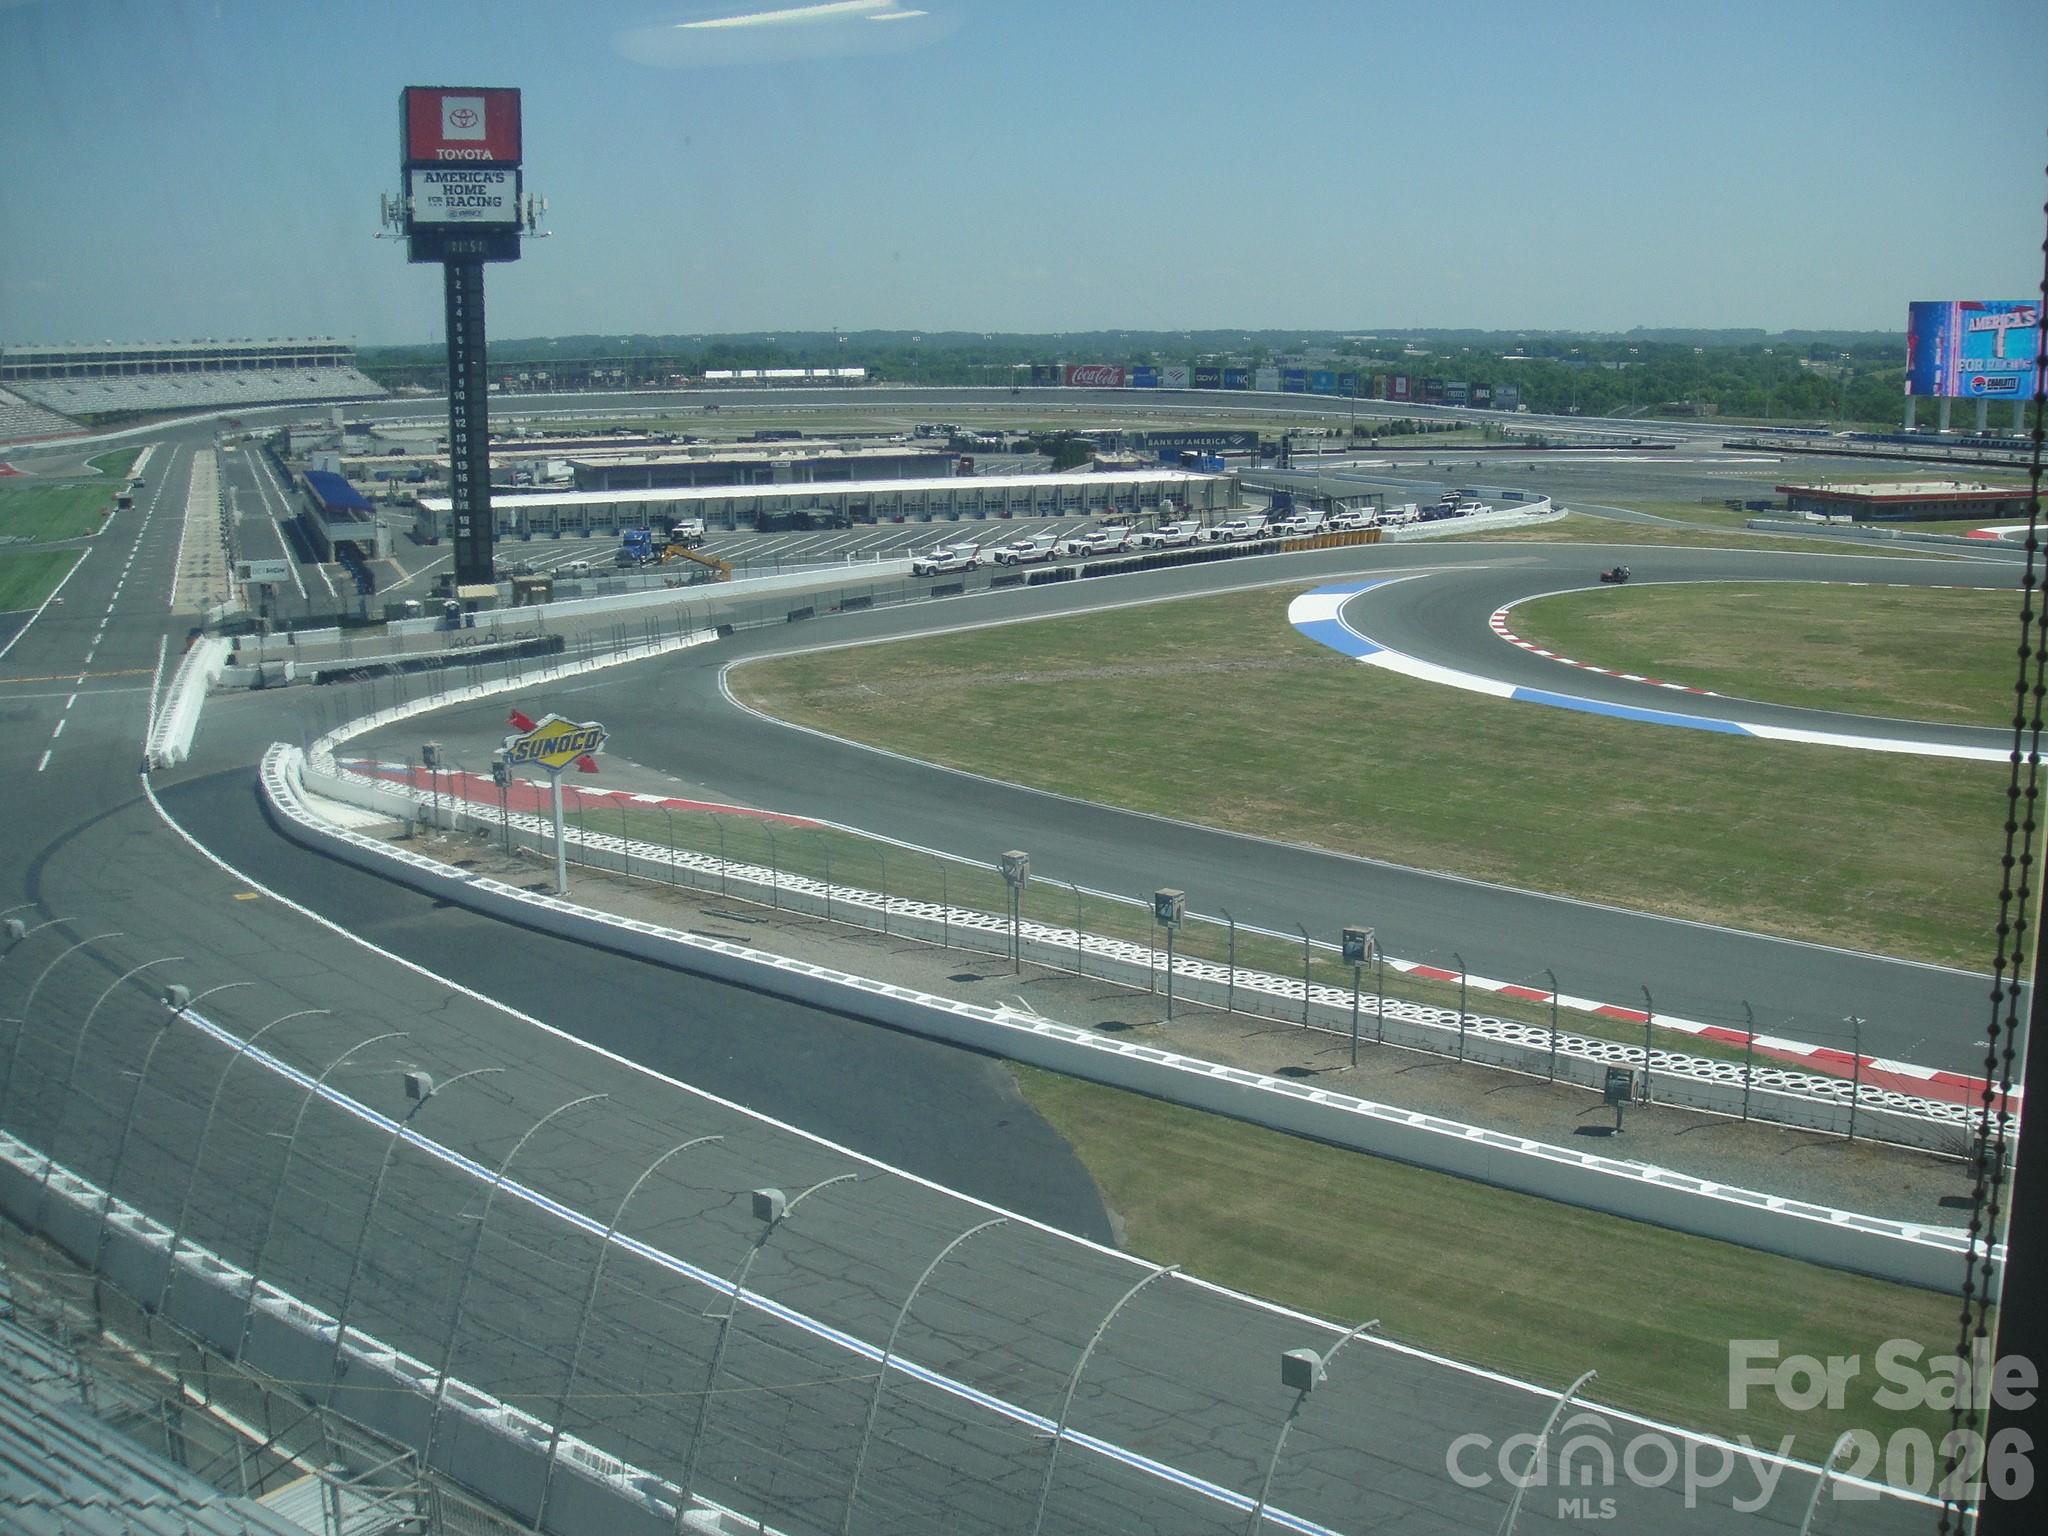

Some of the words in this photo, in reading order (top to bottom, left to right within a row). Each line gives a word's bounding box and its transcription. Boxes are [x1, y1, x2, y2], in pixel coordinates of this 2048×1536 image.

[436, 149, 493, 161] TOYOTA
[424, 172, 505, 184] AMERICA'S
[443, 184, 487, 195] HOME
[445, 196, 502, 207] RACING
[454, 267, 460, 276] 1
[455, 280, 462, 289] 2
[456, 295, 462, 304] 3
[456, 307, 463, 317] 4
[457, 350, 464, 359] 7
[1957, 359, 1983, 373] FOR
[458, 377, 465, 387] 9
[454, 390, 465, 400] 10
[454, 406, 465, 415] 11
[455, 418, 466, 428] 12
[456, 433, 467, 443] 13
[1186, 438, 1226, 446] AMERICA
[456, 446, 467, 455] 14
[457, 461, 468, 470] 15
[456, 473, 468, 482] 16
[459, 515, 470, 525] 19
[515, 729, 600, 760] SUNOCO
